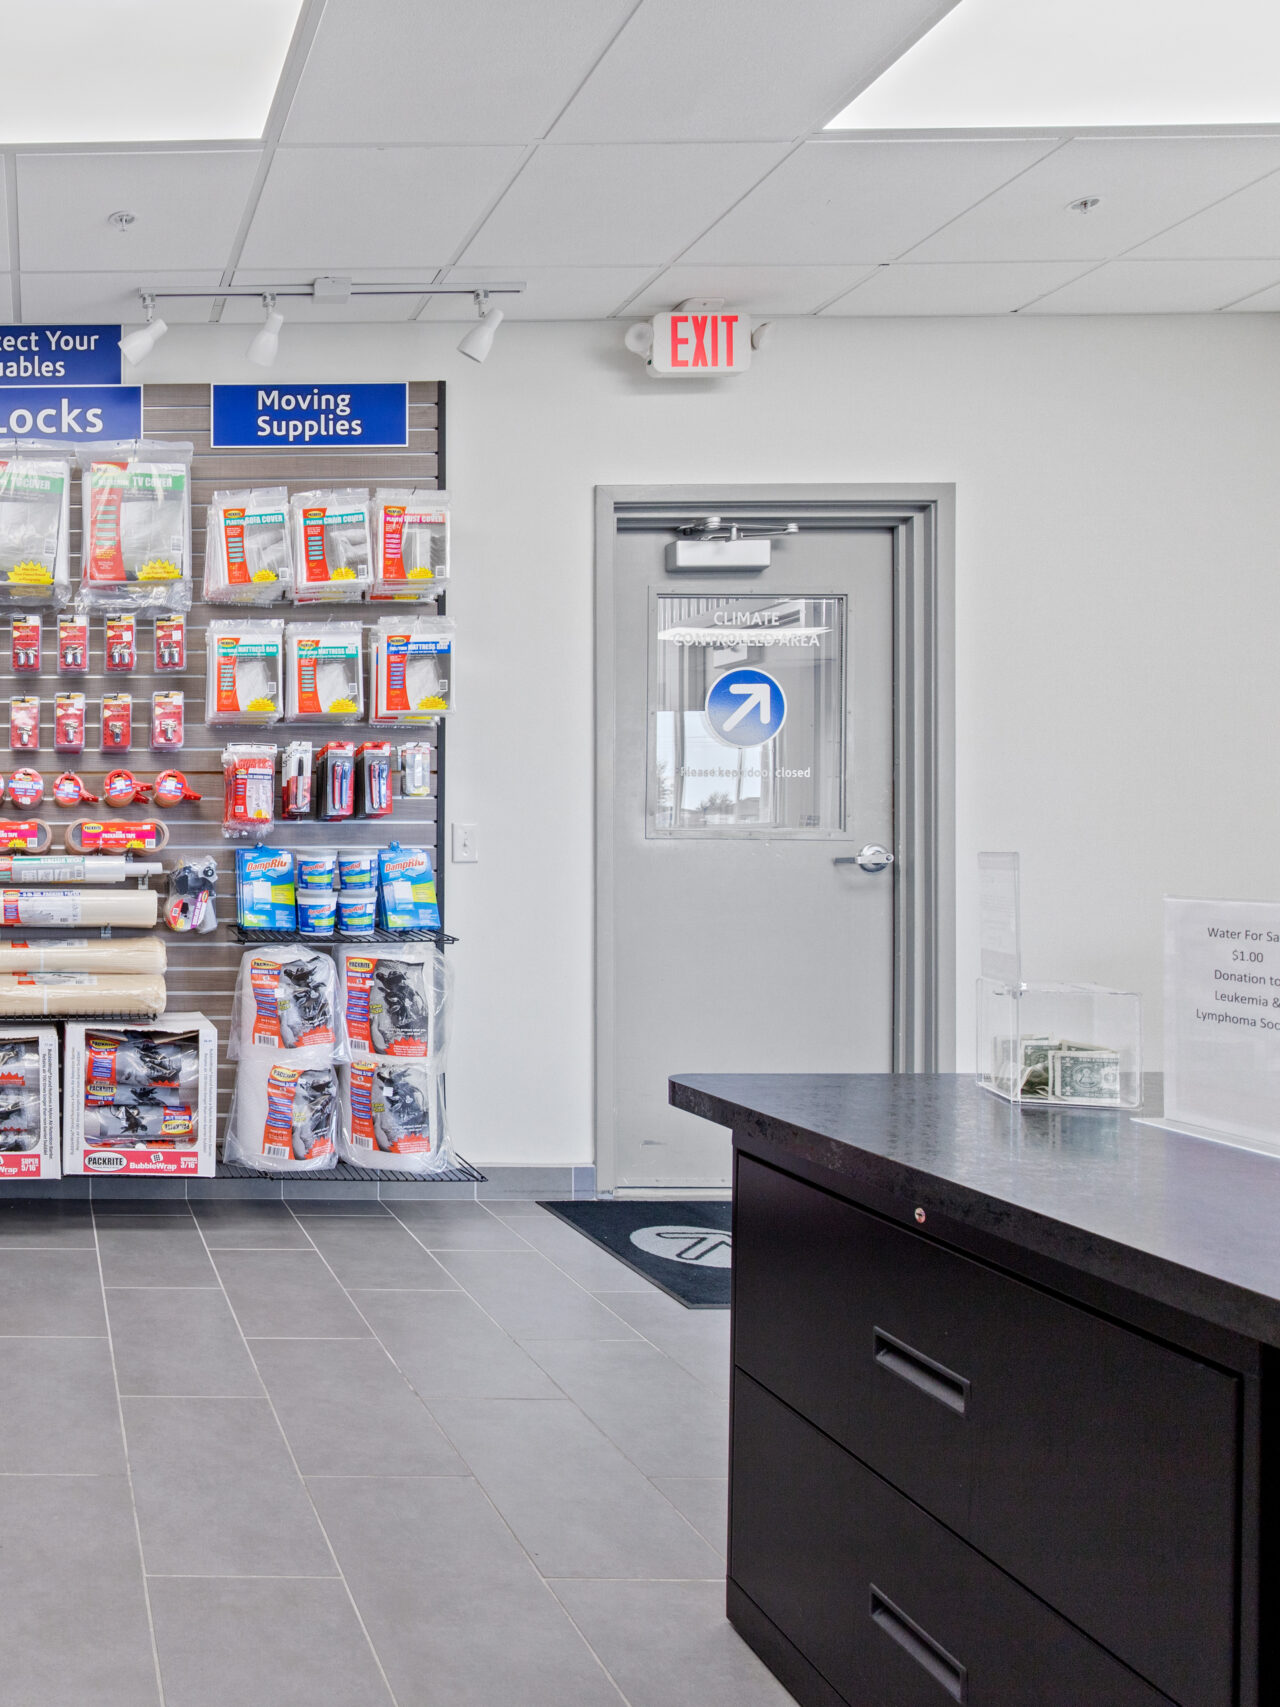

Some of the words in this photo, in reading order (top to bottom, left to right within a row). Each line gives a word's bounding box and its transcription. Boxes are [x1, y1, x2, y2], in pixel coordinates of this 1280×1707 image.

[46, 331, 99, 351] Your
[671, 315, 739, 368] EXIT
[257, 389, 351, 416] Moving
[257, 415, 362, 441] Supplies
[714, 612, 780, 626] CLIMATE
[779, 633, 820, 647] AREA
[775, 767, 811, 778] closed
[1207, 927, 1241, 940] Water
[1244, 929, 1263, 941] For
[1232, 949, 1264, 963] $1.00
[1214, 969, 1266, 986] Donation
[1269, 976, 1280, 987] to
[1215, 990, 1268, 1008] Leukemia
[1196, 1008, 1257, 1028] Lymphoma
[87, 1157, 123, 1166] PACKRITE
[129, 1162, 177, 1171] BubbleWrap
